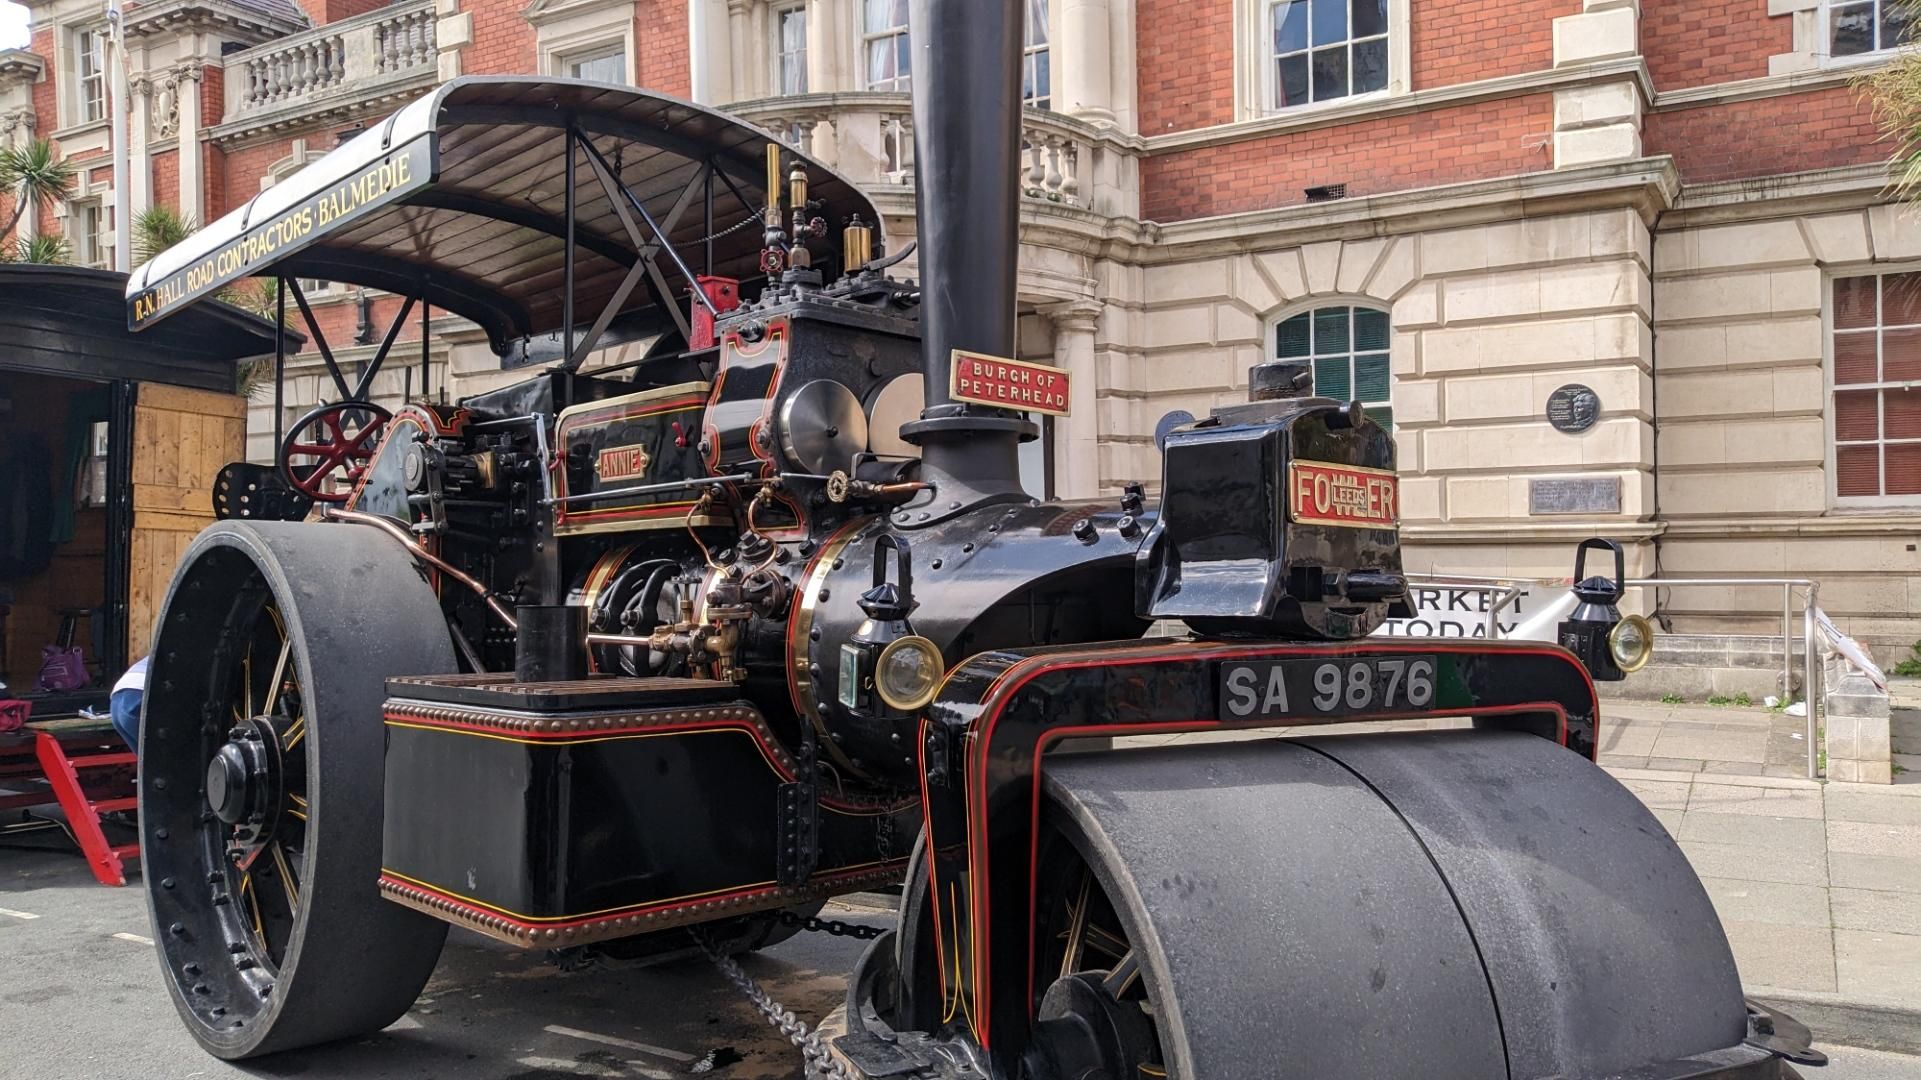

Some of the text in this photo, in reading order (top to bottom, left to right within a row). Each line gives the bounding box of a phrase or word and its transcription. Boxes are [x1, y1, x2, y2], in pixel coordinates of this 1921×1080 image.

[156, 276, 184, 310] HALL
[187, 261, 214, 293] ROAD
[217, 207, 312, 277] CONTRACTORS
[318, 152, 411, 227] BALMEDIE
[973, 362, 1056, 388] BURGH OF
[960, 378, 1065, 407] PETERHEAD
[602, 449, 640, 477] ANNIE
[1333, 486, 1365, 506] LEEDS
[1226, 660, 1433, 716] SA 9876
